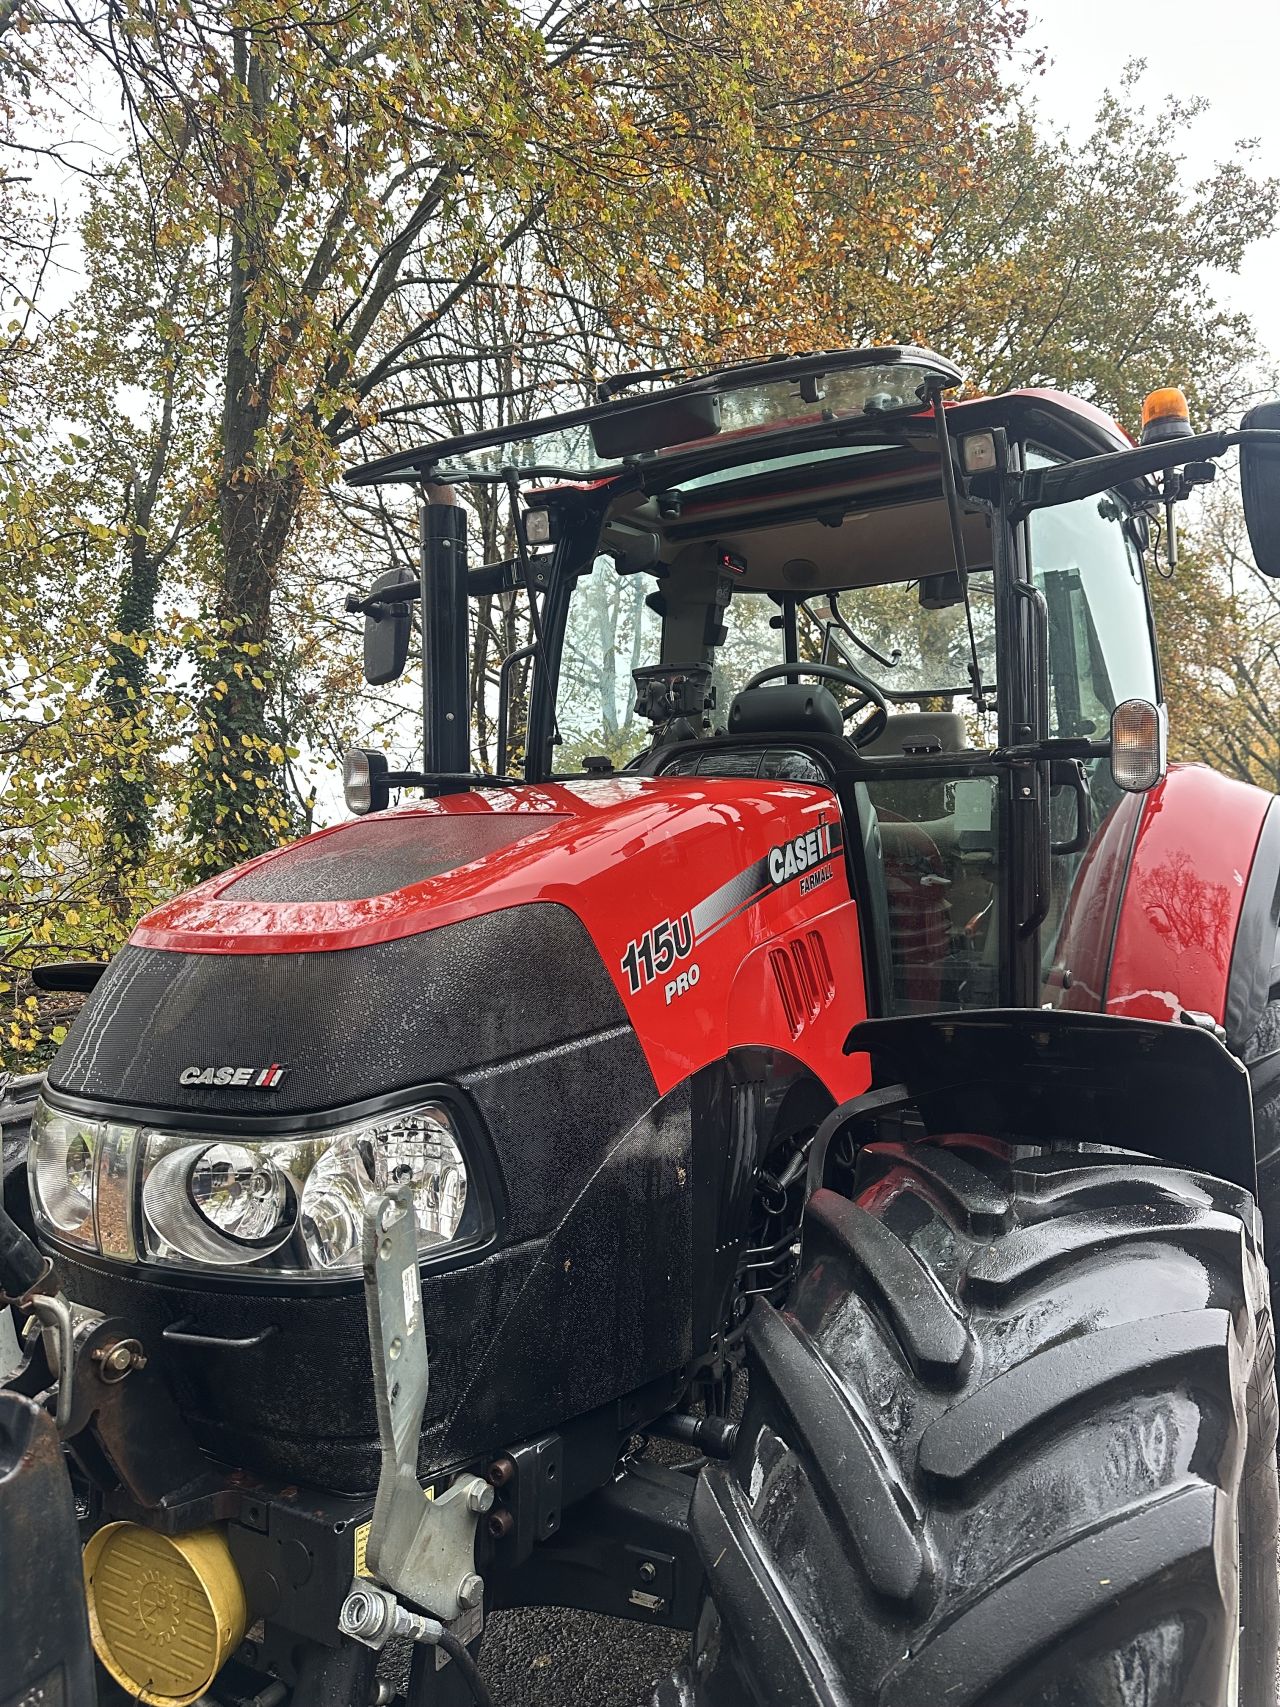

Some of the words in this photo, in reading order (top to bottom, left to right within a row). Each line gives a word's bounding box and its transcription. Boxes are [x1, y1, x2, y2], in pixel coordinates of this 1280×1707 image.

[769, 831, 819, 884] CASE
[800, 864, 834, 896] FARMALL
[621, 911, 693, 995] 115U
[665, 964, 700, 1006] PRO
[180, 1066, 254, 1085] CASE
